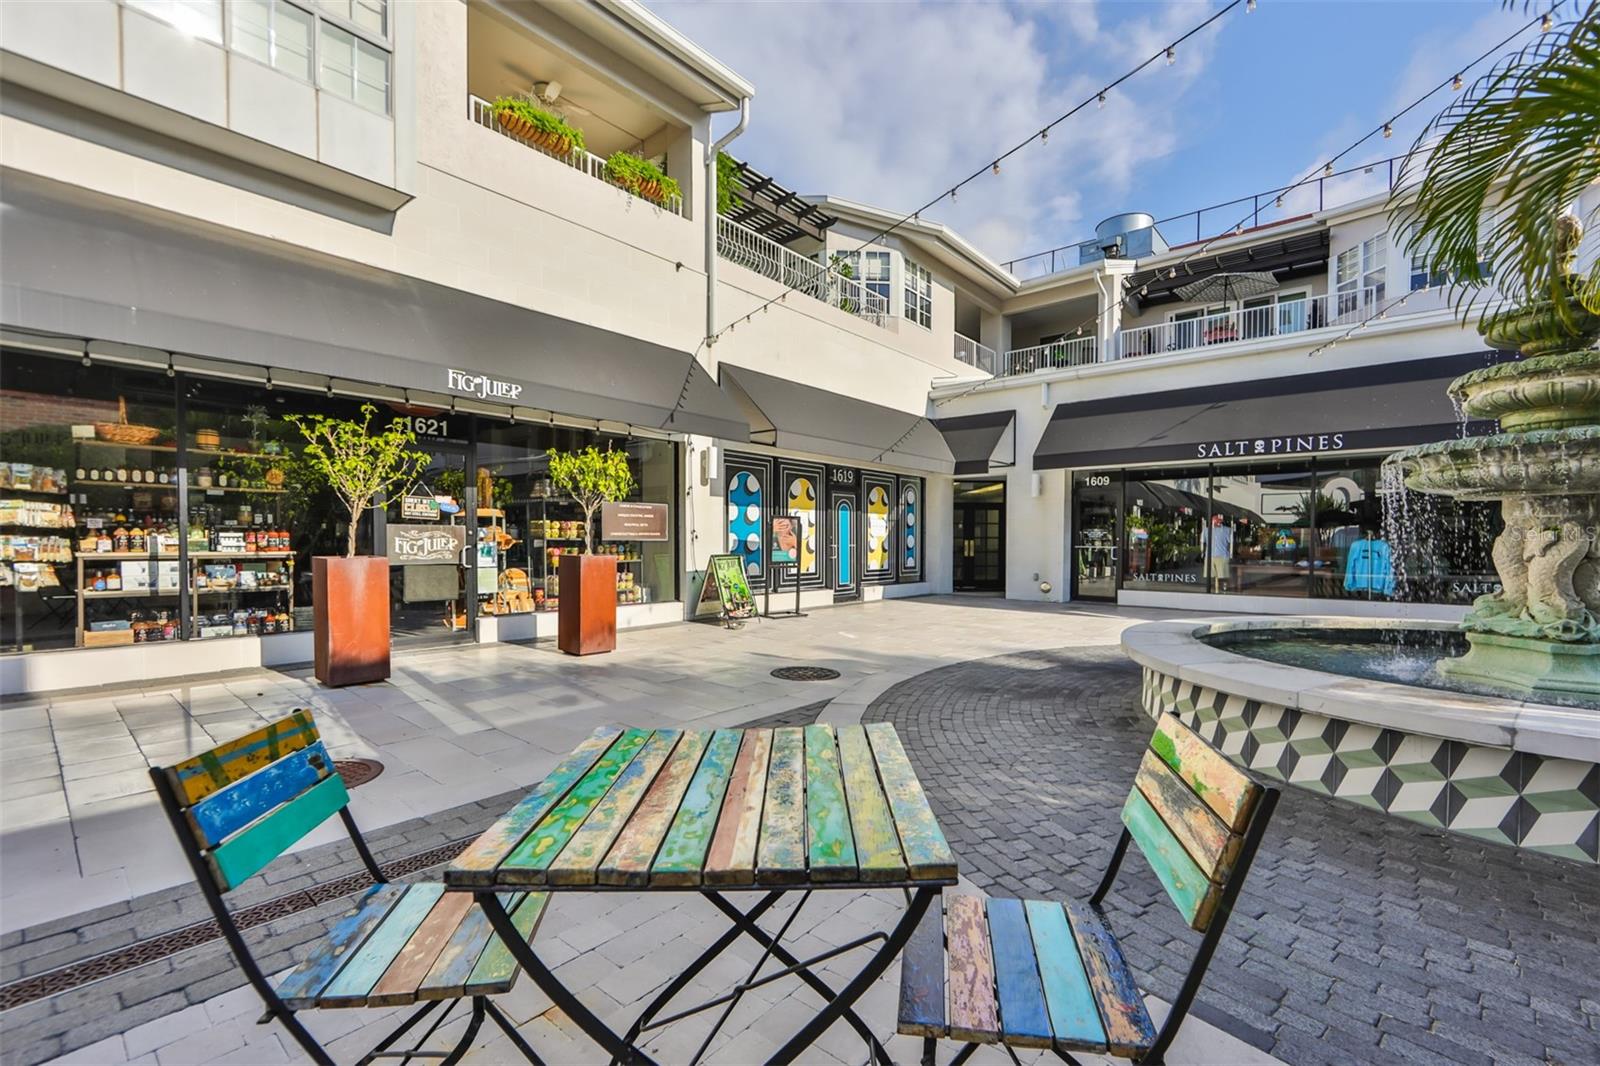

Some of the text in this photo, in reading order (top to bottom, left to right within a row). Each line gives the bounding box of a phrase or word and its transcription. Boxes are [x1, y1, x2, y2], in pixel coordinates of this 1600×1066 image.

[448, 369, 522, 399] FIG JULEP
[404, 416, 447, 436] 1621
[1197, 434, 1344, 458] SALT PINES
[833, 469, 854, 483] 1619
[1085, 476, 1110, 486] 1609
[394, 537, 418, 555] FIG
[1133, 573, 1197, 583] SALT PINES
[1452, 582, 1492, 593] SALT
